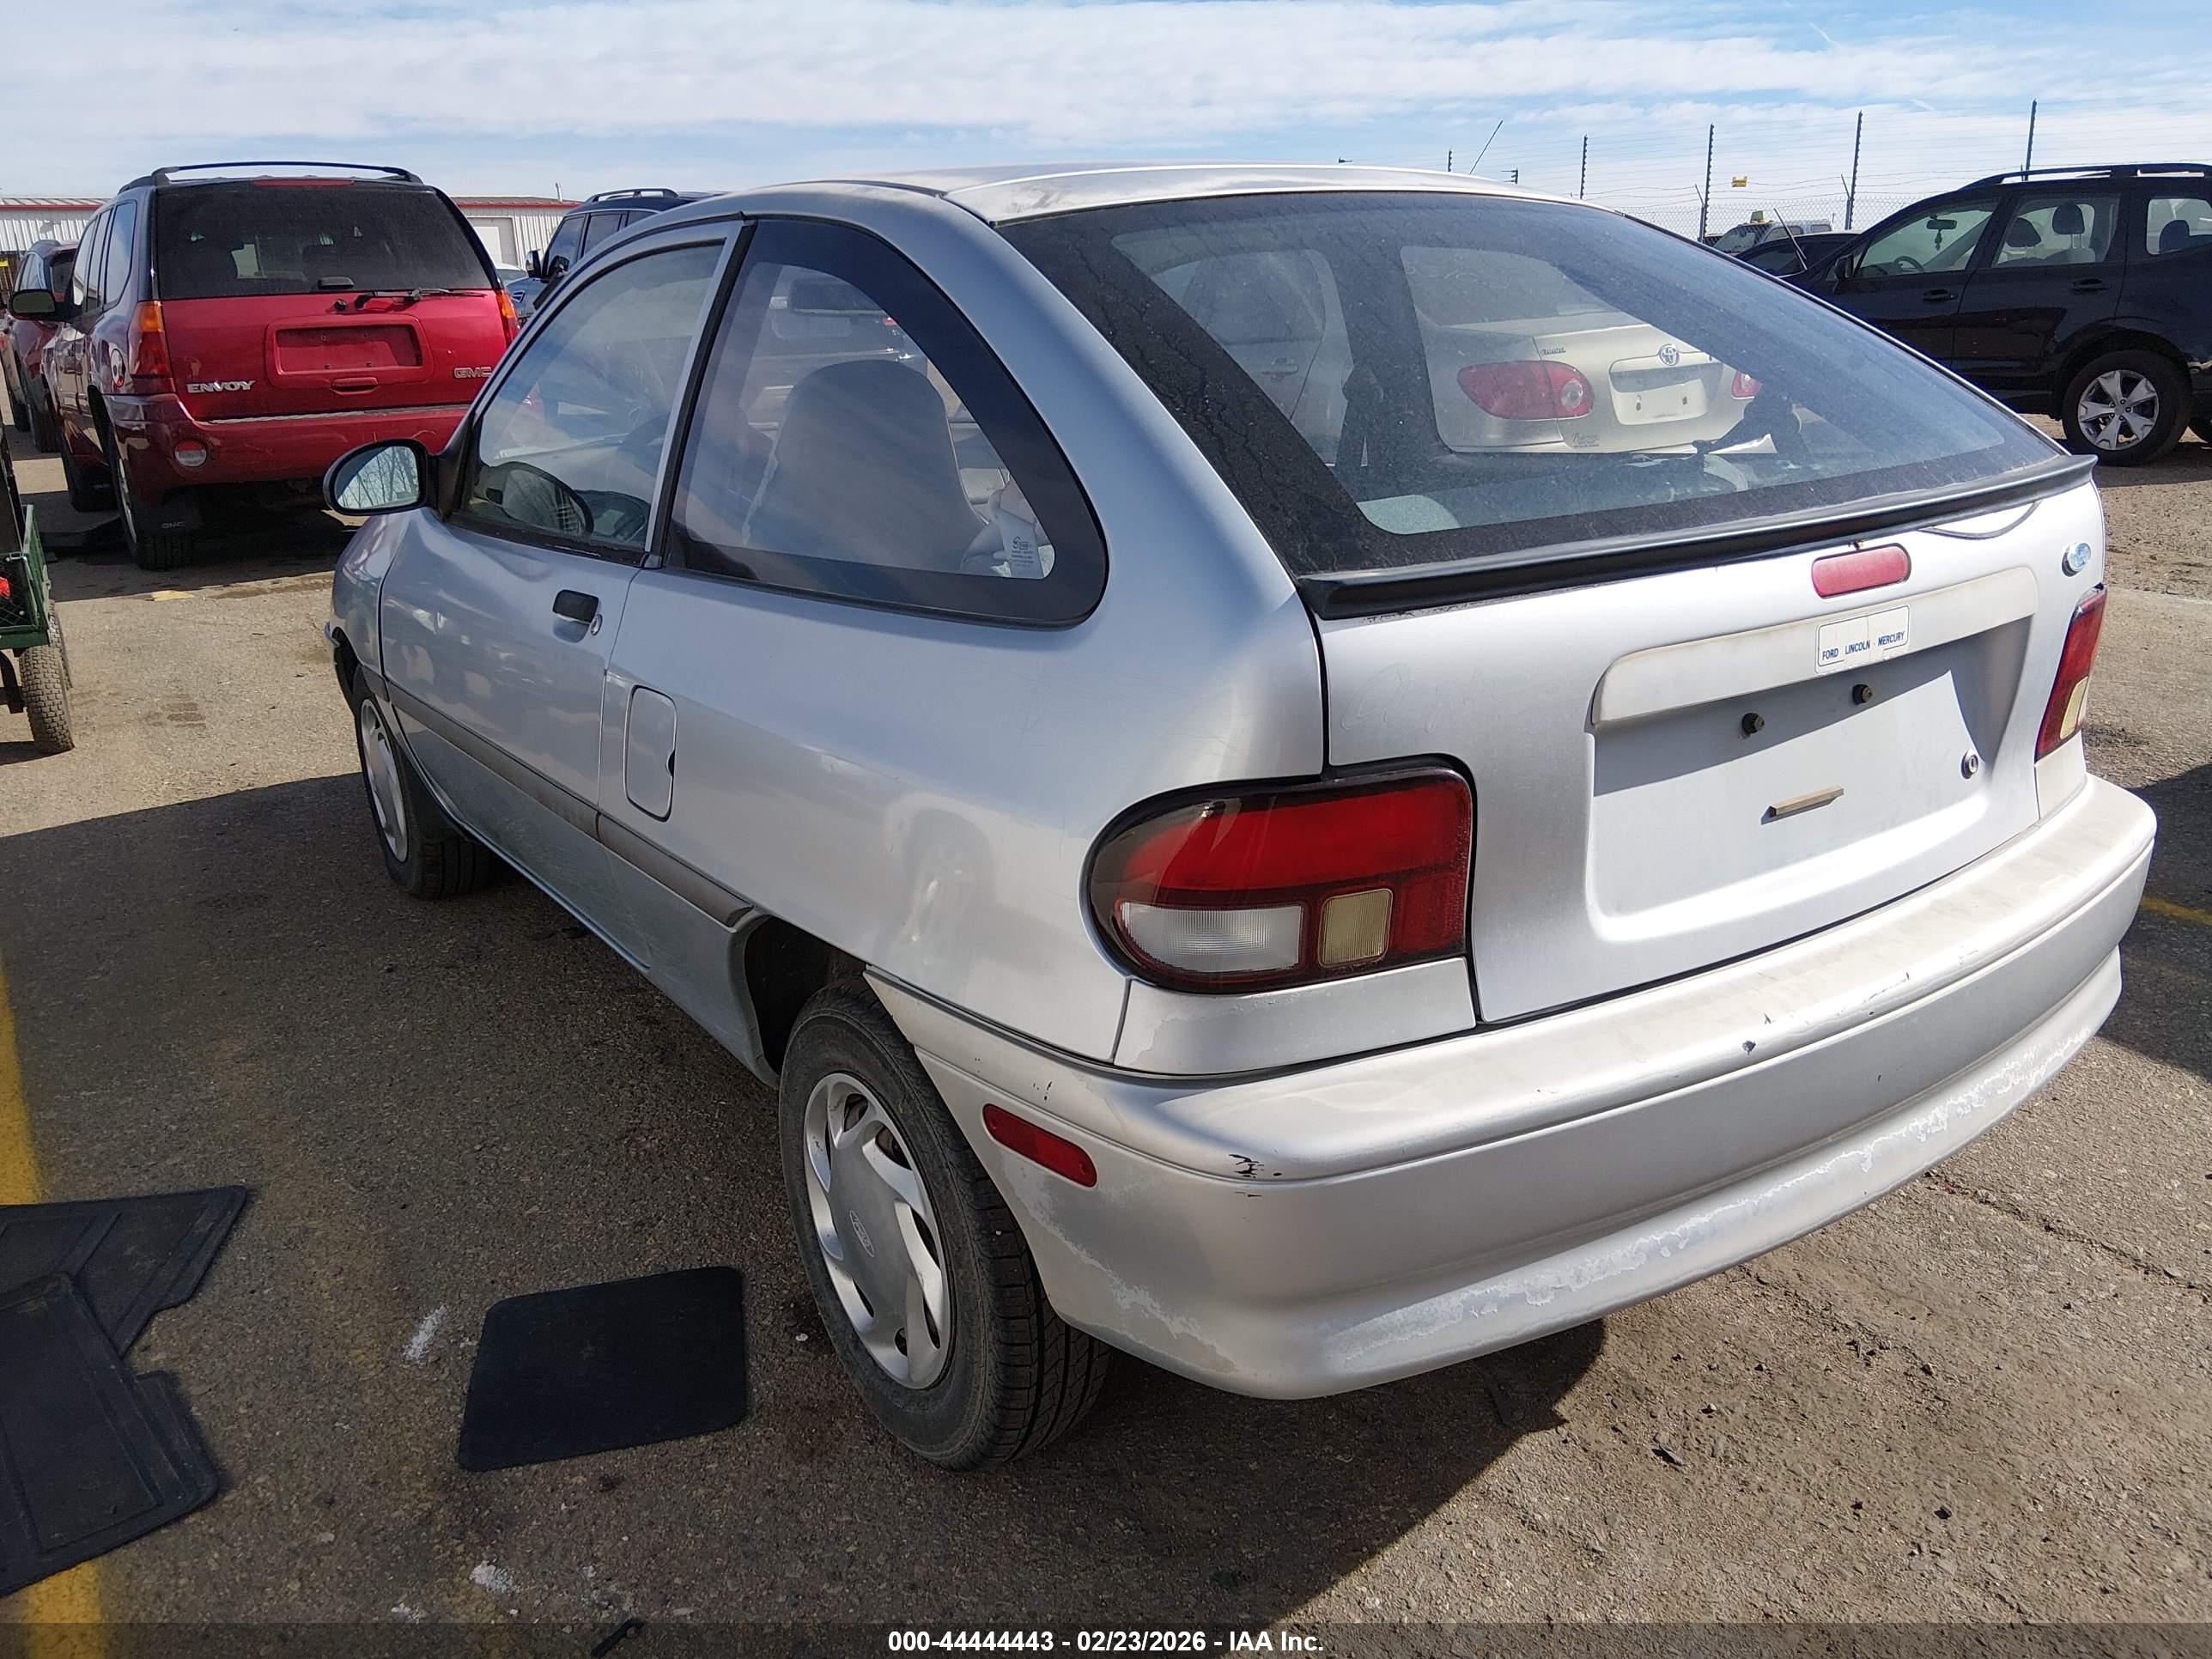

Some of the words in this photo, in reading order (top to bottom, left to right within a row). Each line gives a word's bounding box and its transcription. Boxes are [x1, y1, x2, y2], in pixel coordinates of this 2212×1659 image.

[453, 366, 492, 379] GMC
[185, 380, 256, 393] ENVOY
[1822, 648, 1838, 660] FORD
[1845, 640, 1870, 654] LINCOLN
[1878, 631, 1905, 646] MERCURY
